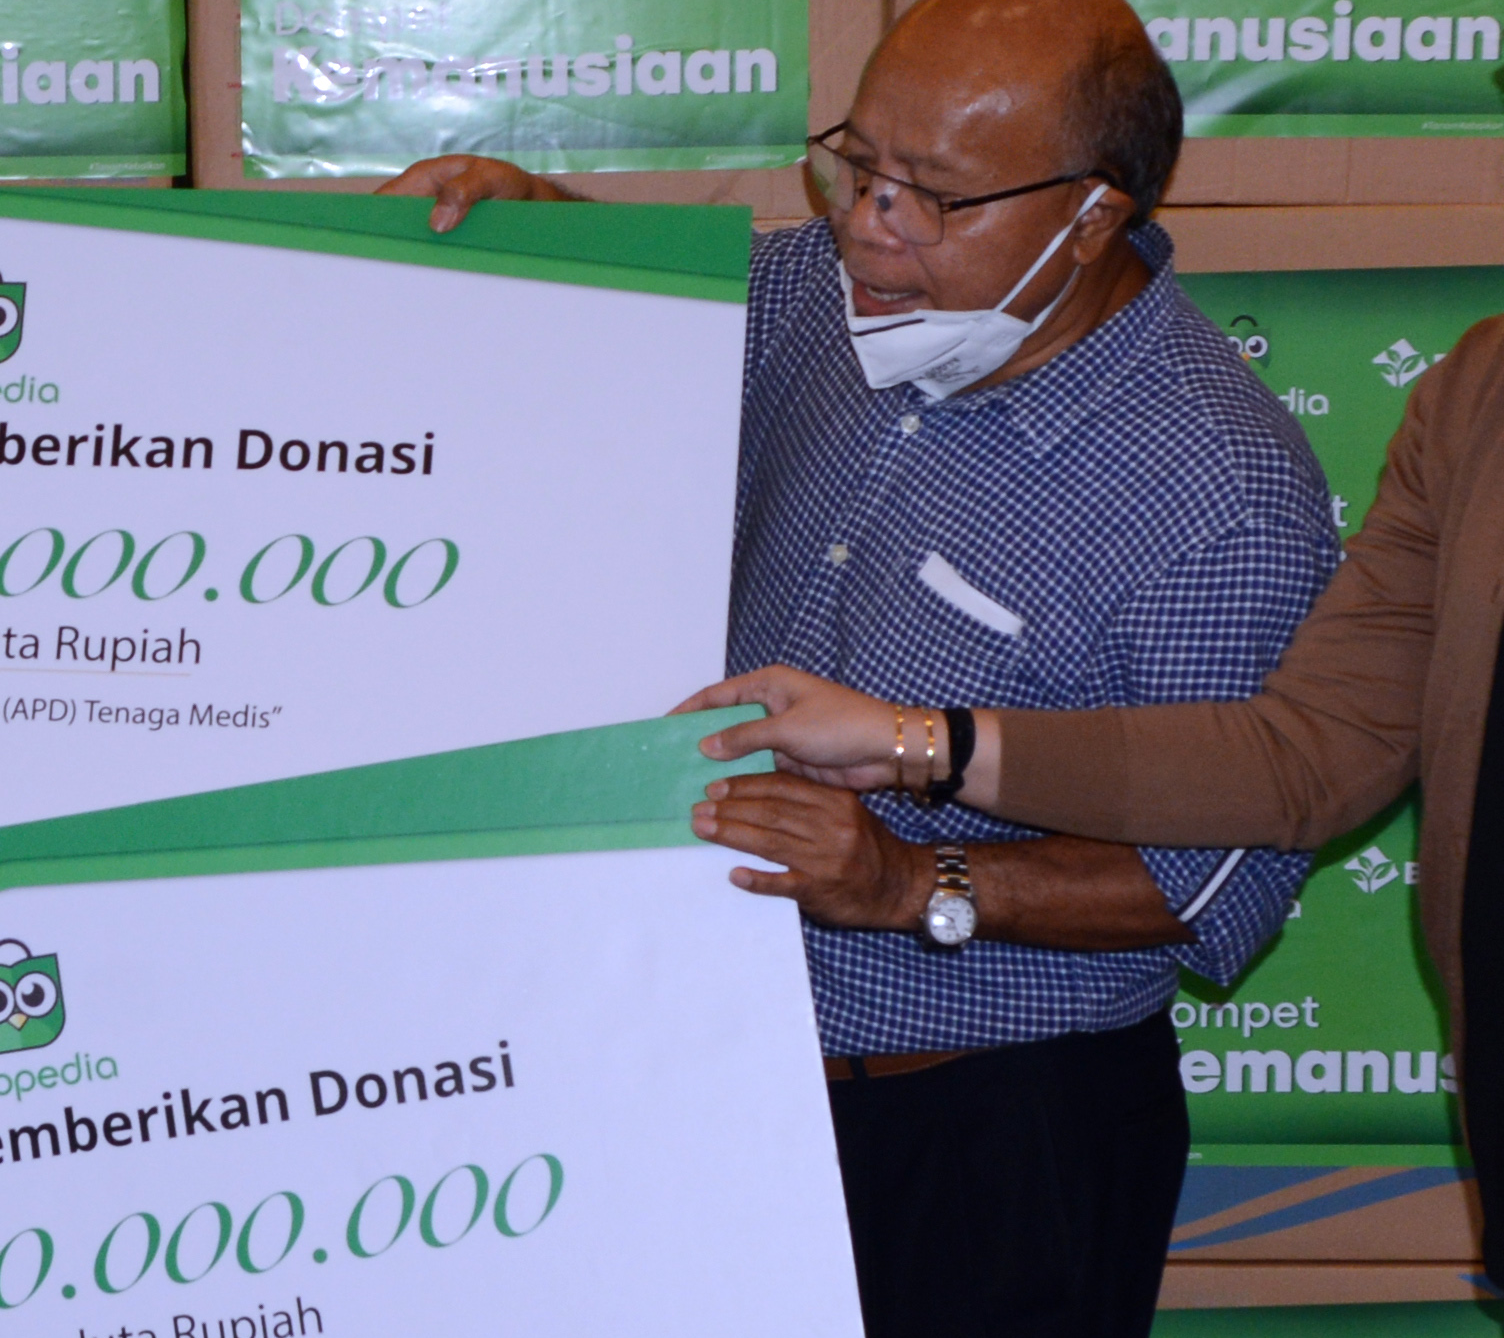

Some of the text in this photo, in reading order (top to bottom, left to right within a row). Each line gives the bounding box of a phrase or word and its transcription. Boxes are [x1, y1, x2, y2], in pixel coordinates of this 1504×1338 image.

[272, 35, 779, 103] Kemanusiaan
[237, 430, 433, 475] Donasi
[56, 626, 200, 672] Rupiah
[3, 698, 76, 724] (APD)
[85, 700, 180, 731] Tenaga
[189, 704, 282, 728] Medis”
[310, 1041, 513, 1116] Donasi
